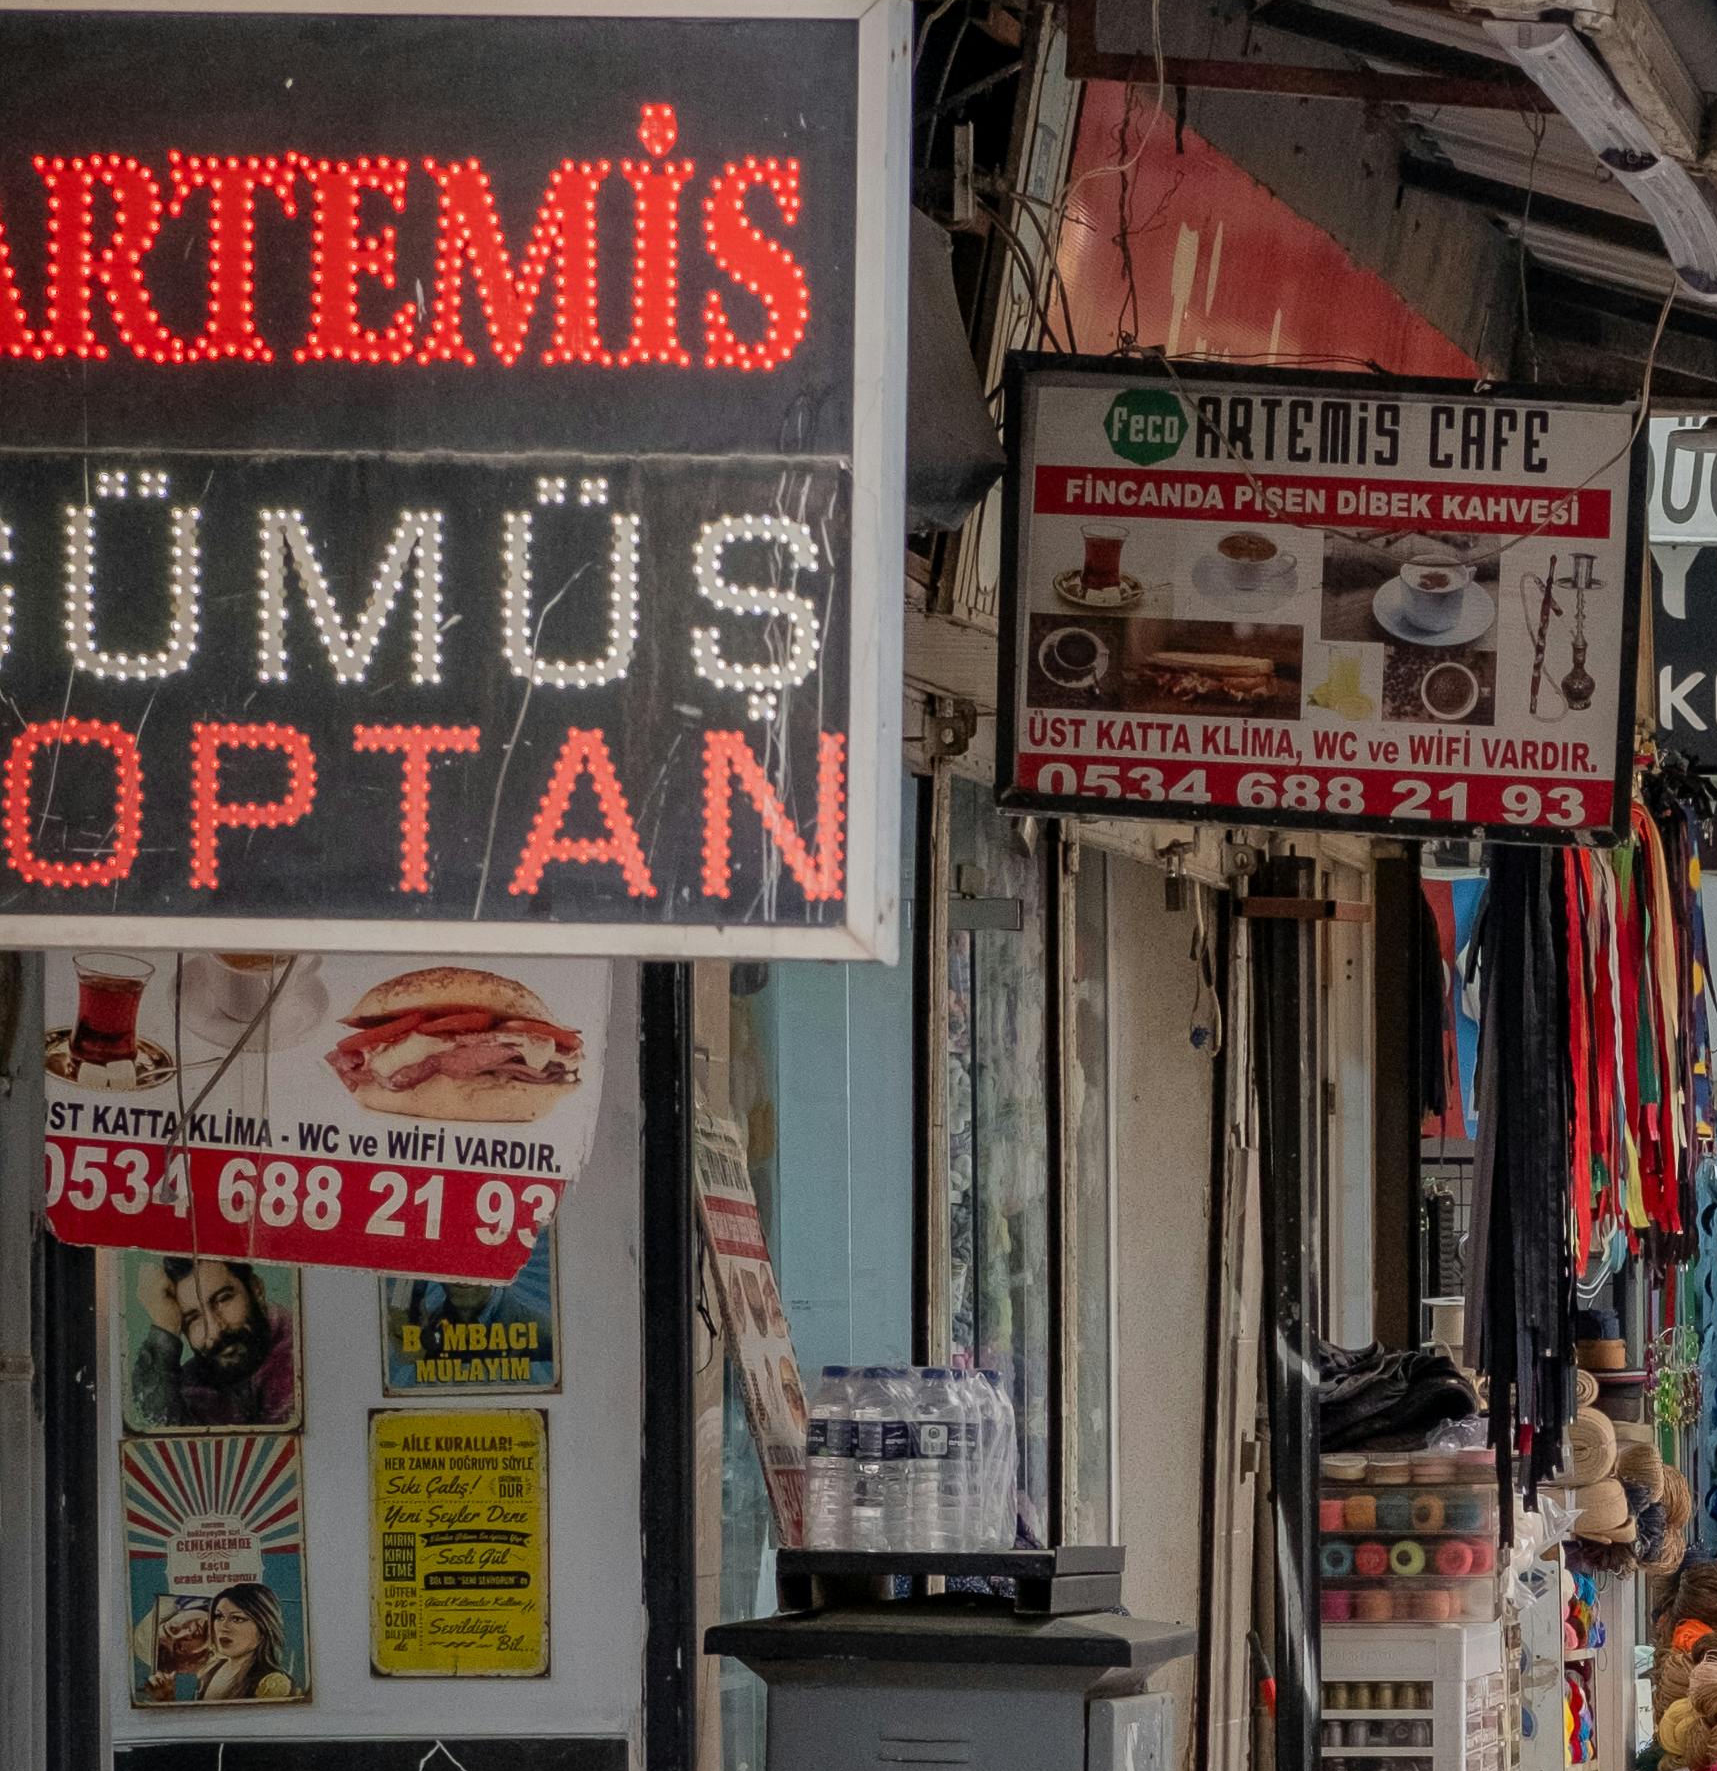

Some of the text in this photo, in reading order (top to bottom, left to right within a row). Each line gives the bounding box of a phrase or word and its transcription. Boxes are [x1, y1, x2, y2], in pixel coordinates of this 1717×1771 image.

[1430, 406, 1550, 473] CAFE
[1066, 476, 1222, 511] FİNCANDA
[1337, 484, 1430, 520] DİBEK
[1442, 490, 1580, 527] KAHVESİ
[0, 475, 821, 722] ÜMÜŞ
[1029, 709, 1085, 749] ÜST
[1096, 713, 1191, 755] KATTA
[1313, 730, 1358, 763] WC
[1368, 737, 1400, 766] ve
[1392, 778, 1469, 822] 21
[1499, 785, 1587, 826] 93
[94, 1106, 179, 1142] KATTA
[189, 1108, 274, 1148] KLİMA
[299, 1121, 341, 1154] WC
[348, 1134, 379, 1158] ve
[217, 1157, 344, 1232] 688
[364, 1170, 446, 1240] 21
[384, 1457, 406, 1471] HER
[408, 1457, 446, 1471] ZAMAN
[402, 1433, 432, 1453] AİLE
